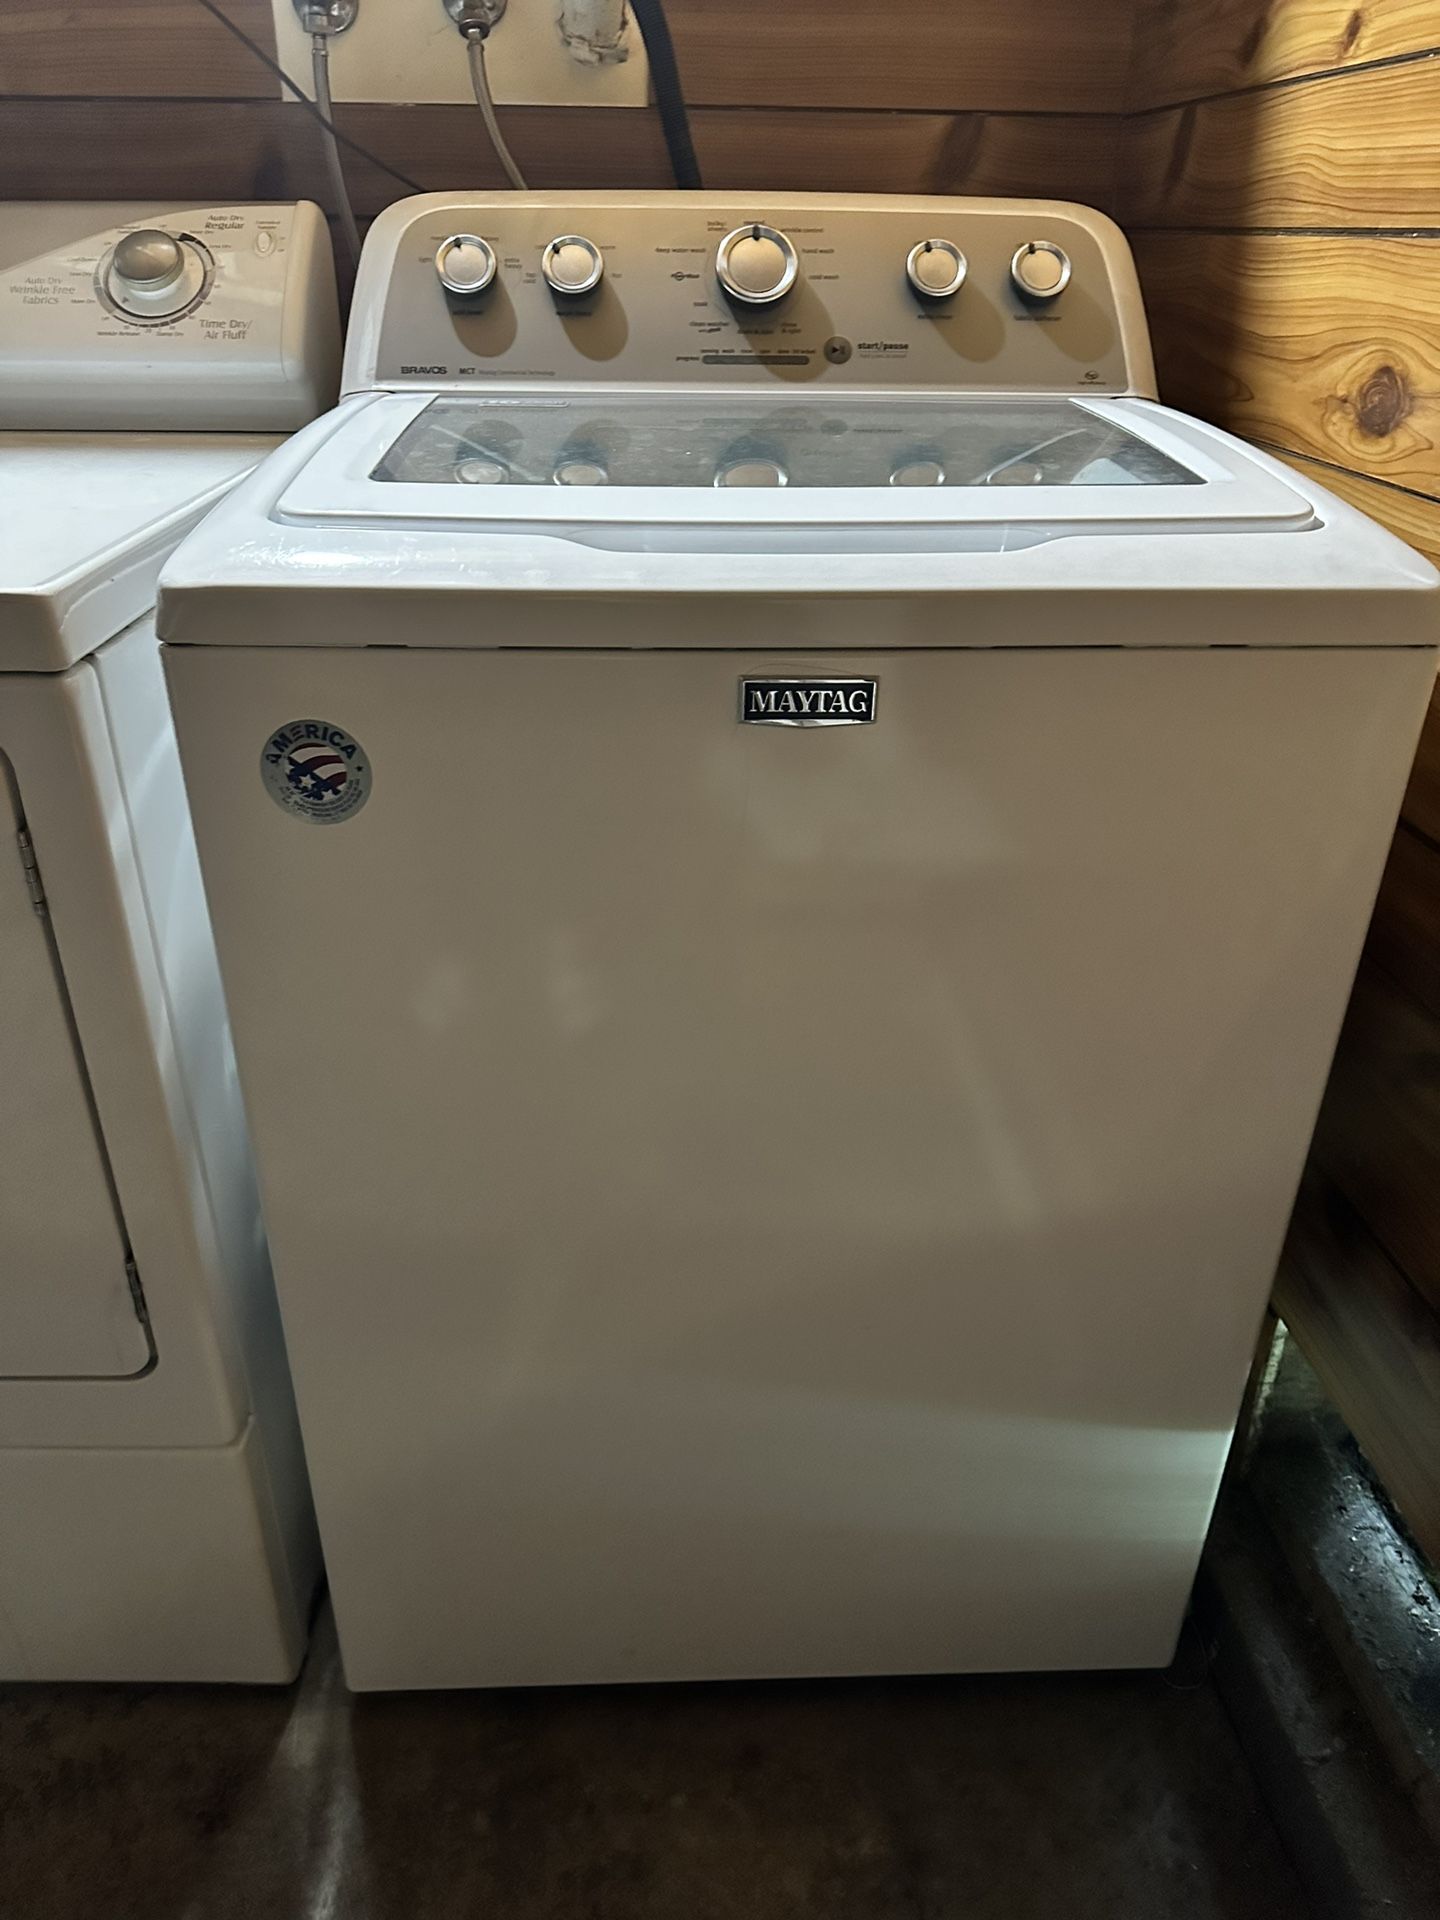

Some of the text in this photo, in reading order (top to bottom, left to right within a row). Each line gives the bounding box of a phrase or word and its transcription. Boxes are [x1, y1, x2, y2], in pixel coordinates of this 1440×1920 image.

[204, 222, 245, 230] Regular
[10, 286, 76, 294] Wrinkle Free
[23, 296, 60, 304] Fabrics
[200, 319, 227, 328] Time
[204, 330, 247, 340] Air Fluff
[858, 340, 909, 351] start/pause
[401, 366, 448, 375] BRAVOS
[750, 690, 868, 712] MAYTAG
[266, 724, 357, 764] AMERICA
